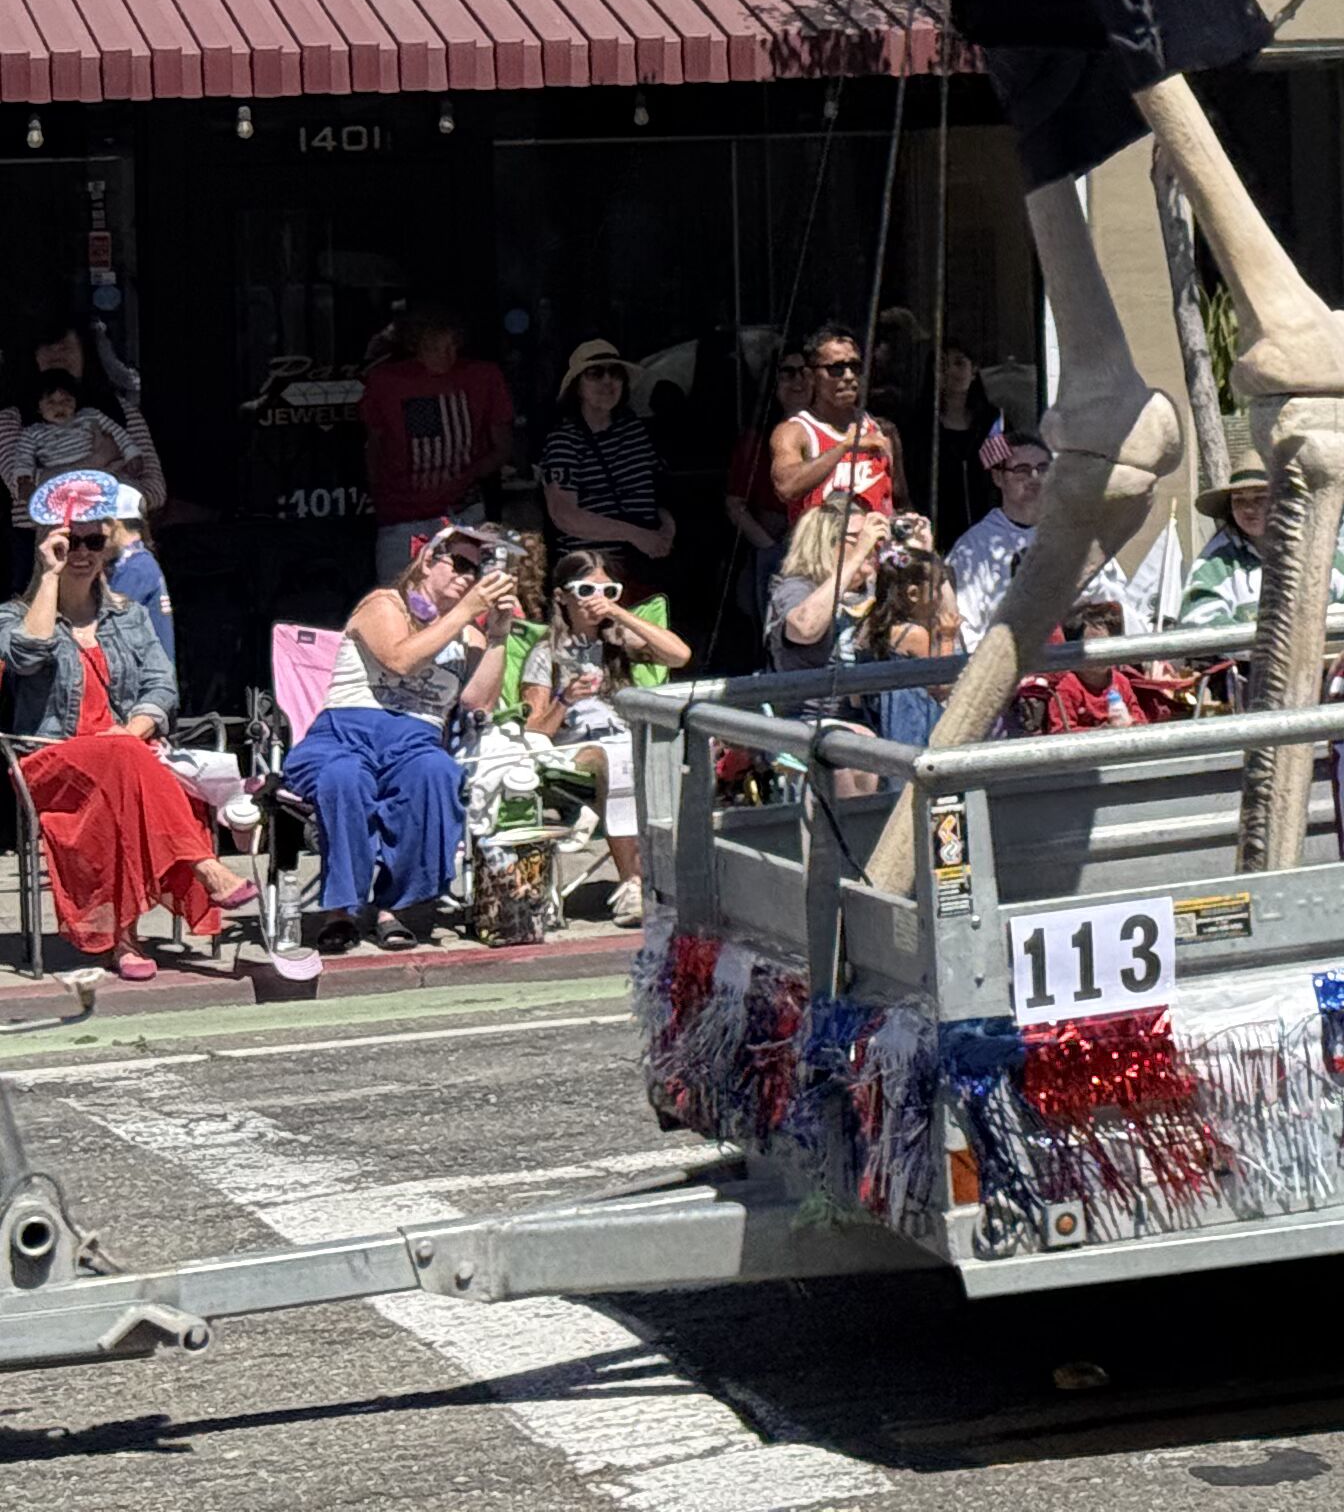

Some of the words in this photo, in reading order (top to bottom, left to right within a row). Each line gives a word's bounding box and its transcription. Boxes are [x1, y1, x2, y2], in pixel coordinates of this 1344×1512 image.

[298, 125, 381, 153] 1401
[258, 405, 362, 428] JEWELE
[1022, 913, 1163, 1010] 113
